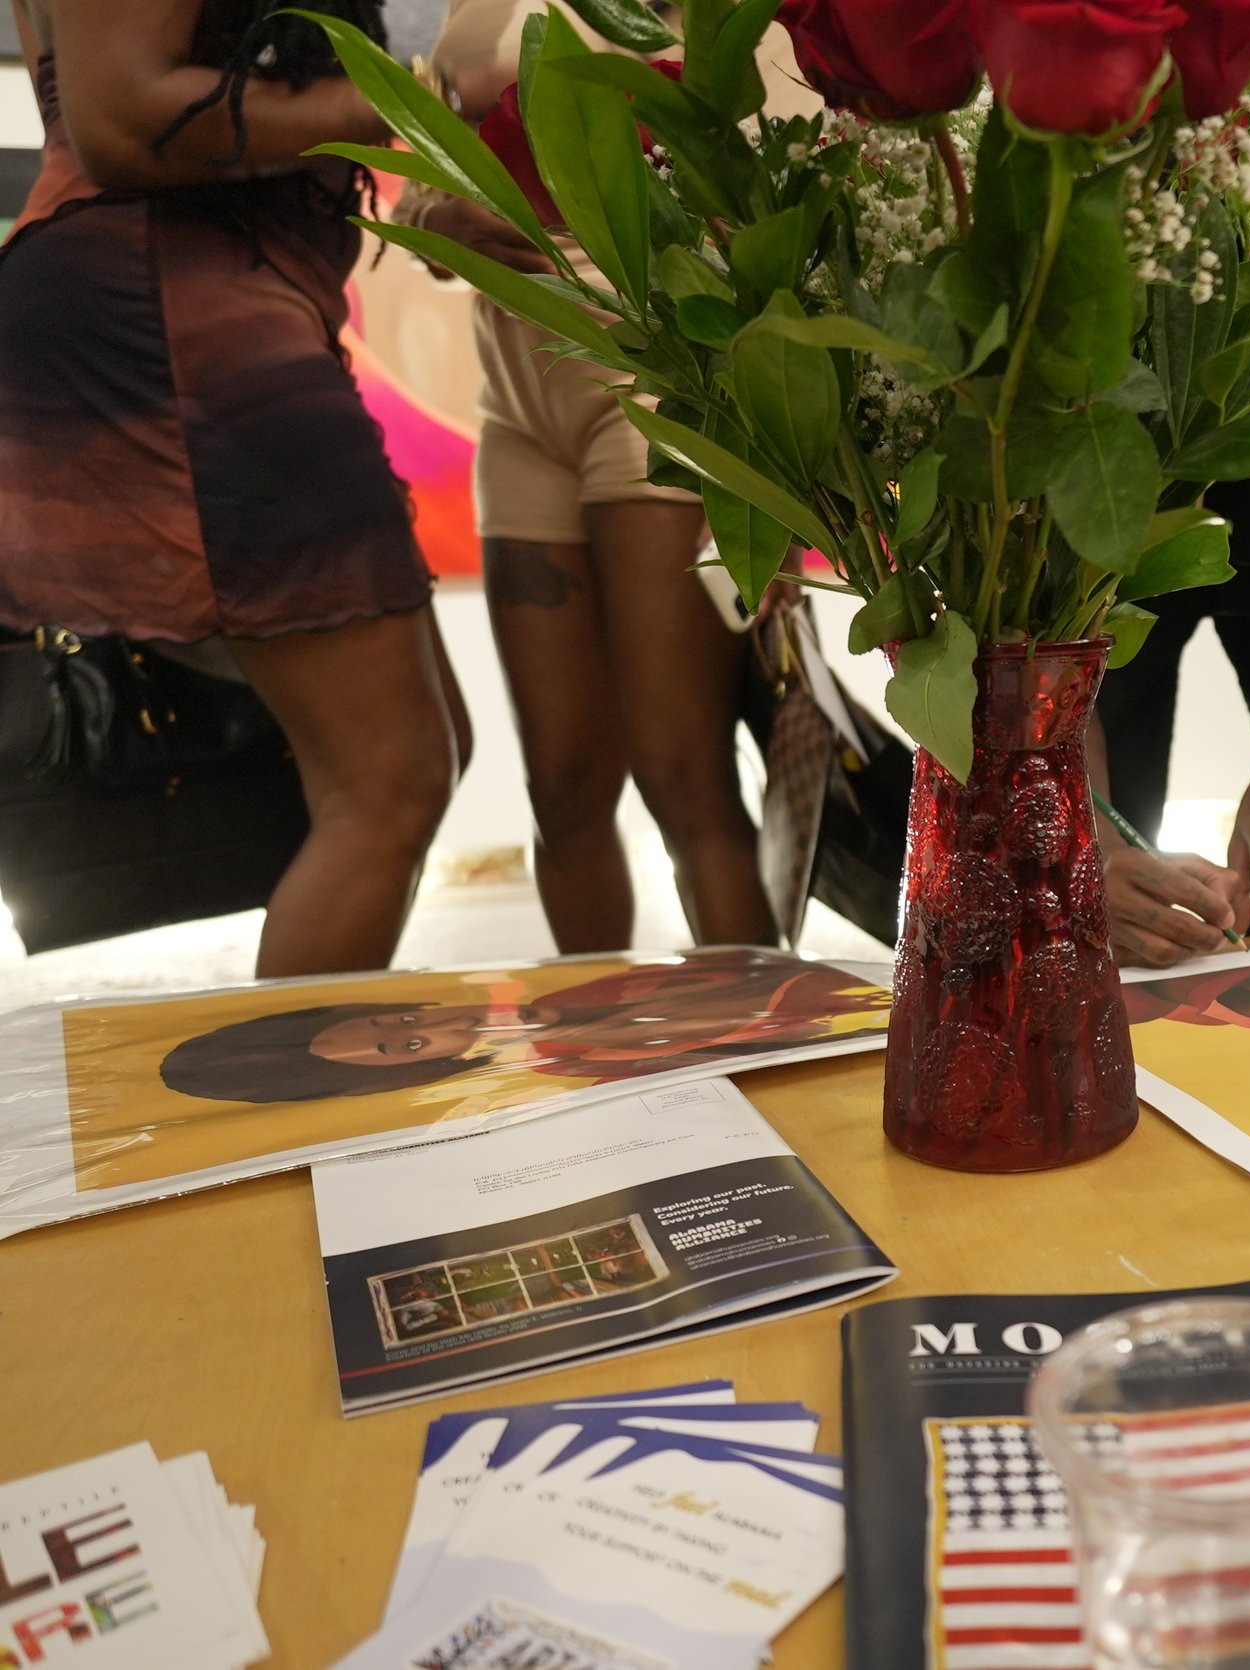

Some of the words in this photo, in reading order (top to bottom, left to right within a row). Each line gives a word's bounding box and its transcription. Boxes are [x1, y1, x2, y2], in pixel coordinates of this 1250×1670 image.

[653, 1195, 711, 1214] Exploring
[713, 1190, 734, 1199] our
[736, 1183, 767, 1195] past.
[657, 1198, 730, 1220] Considering
[732, 1193, 752, 1202] our
[753, 1185, 795, 1197] future.
[660, 1213, 697, 1227] Every
[698, 1206, 729, 1219] year.
[668, 1219, 736, 1241] ALABAMA
[671, 1218, 763, 1247] HUMANITIES
[675, 1228, 748, 1251] ALLIANCE
